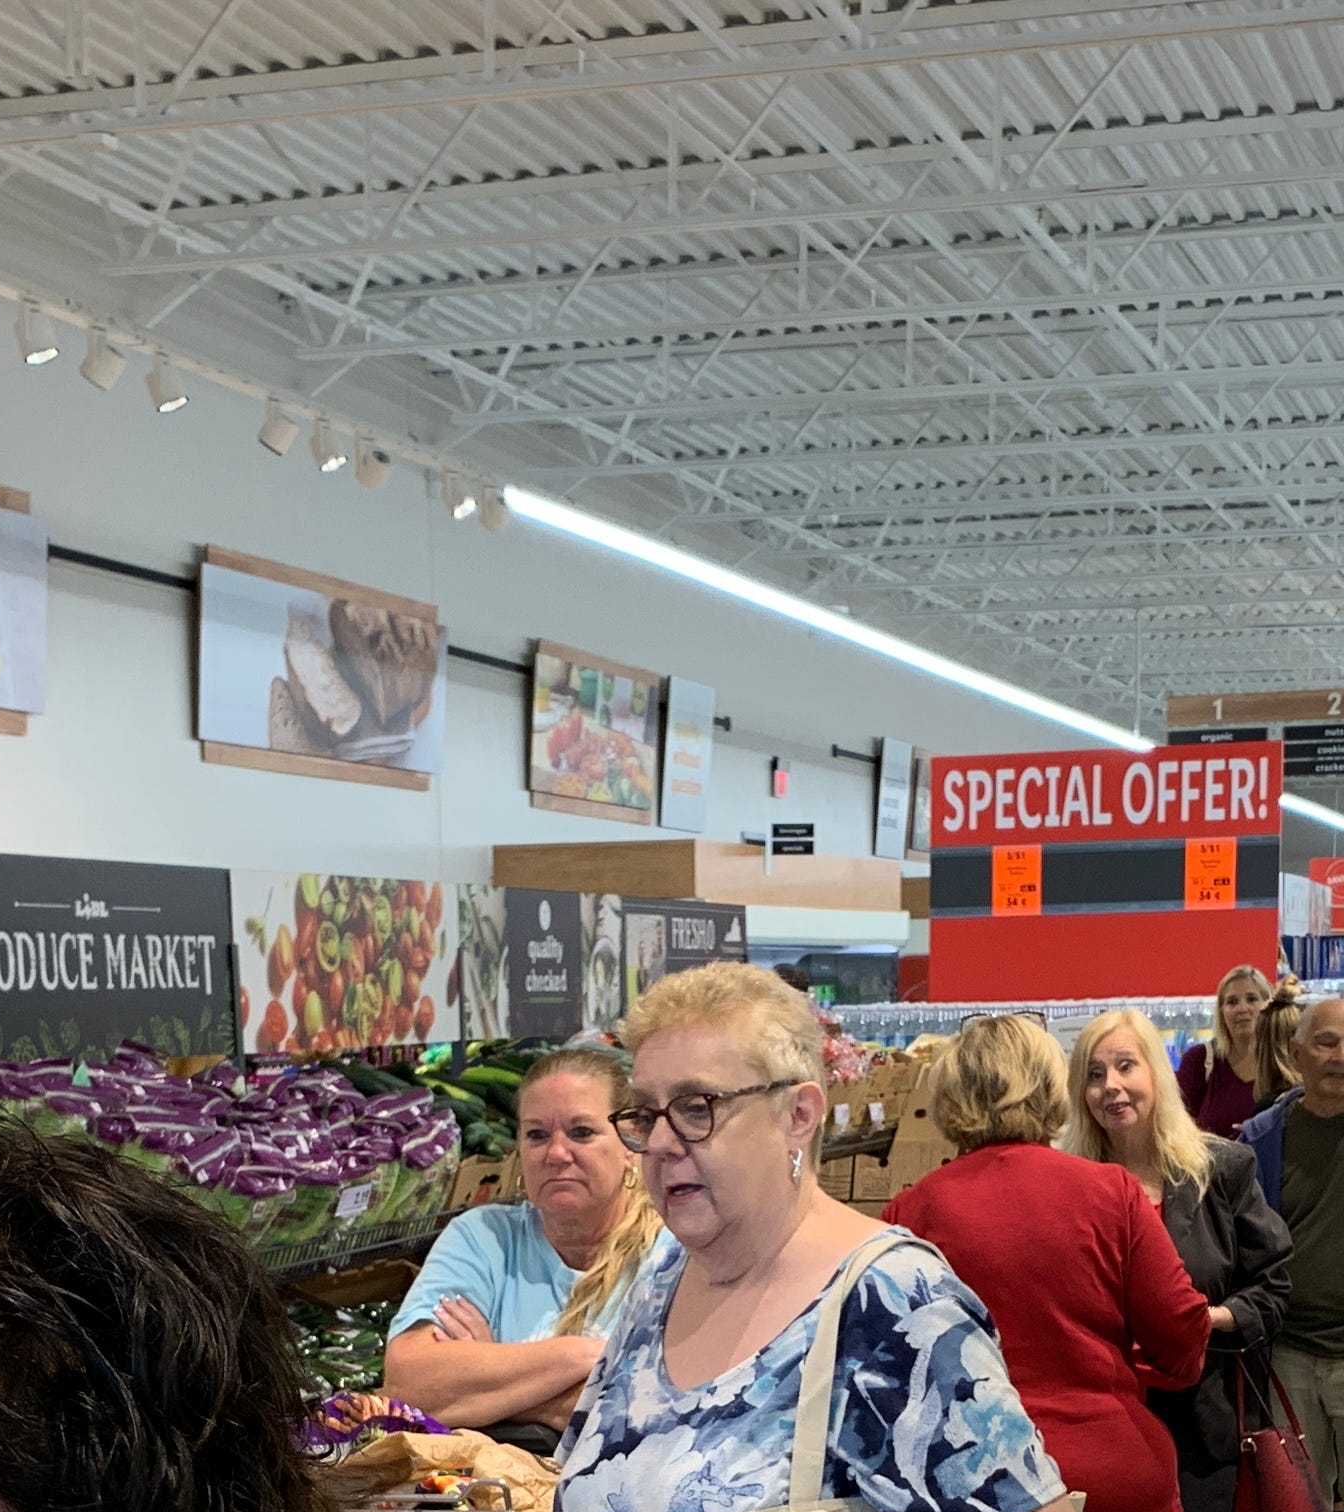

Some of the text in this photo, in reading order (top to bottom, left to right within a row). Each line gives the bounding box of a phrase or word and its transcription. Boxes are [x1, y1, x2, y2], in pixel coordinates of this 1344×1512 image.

[1212, 698, 1223, 720] 1
[1327, 691, 1342, 715] 2
[1200, 732, 1234, 743] organic
[1324, 727, 1344, 737] nuts
[942, 763, 1113, 832] SPECIAL
[1122, 756, 1269, 825] OFFER!
[527, 934, 564, 964] quality
[105, 934, 215, 995] MARKET
[525, 967, 568, 993] checked
